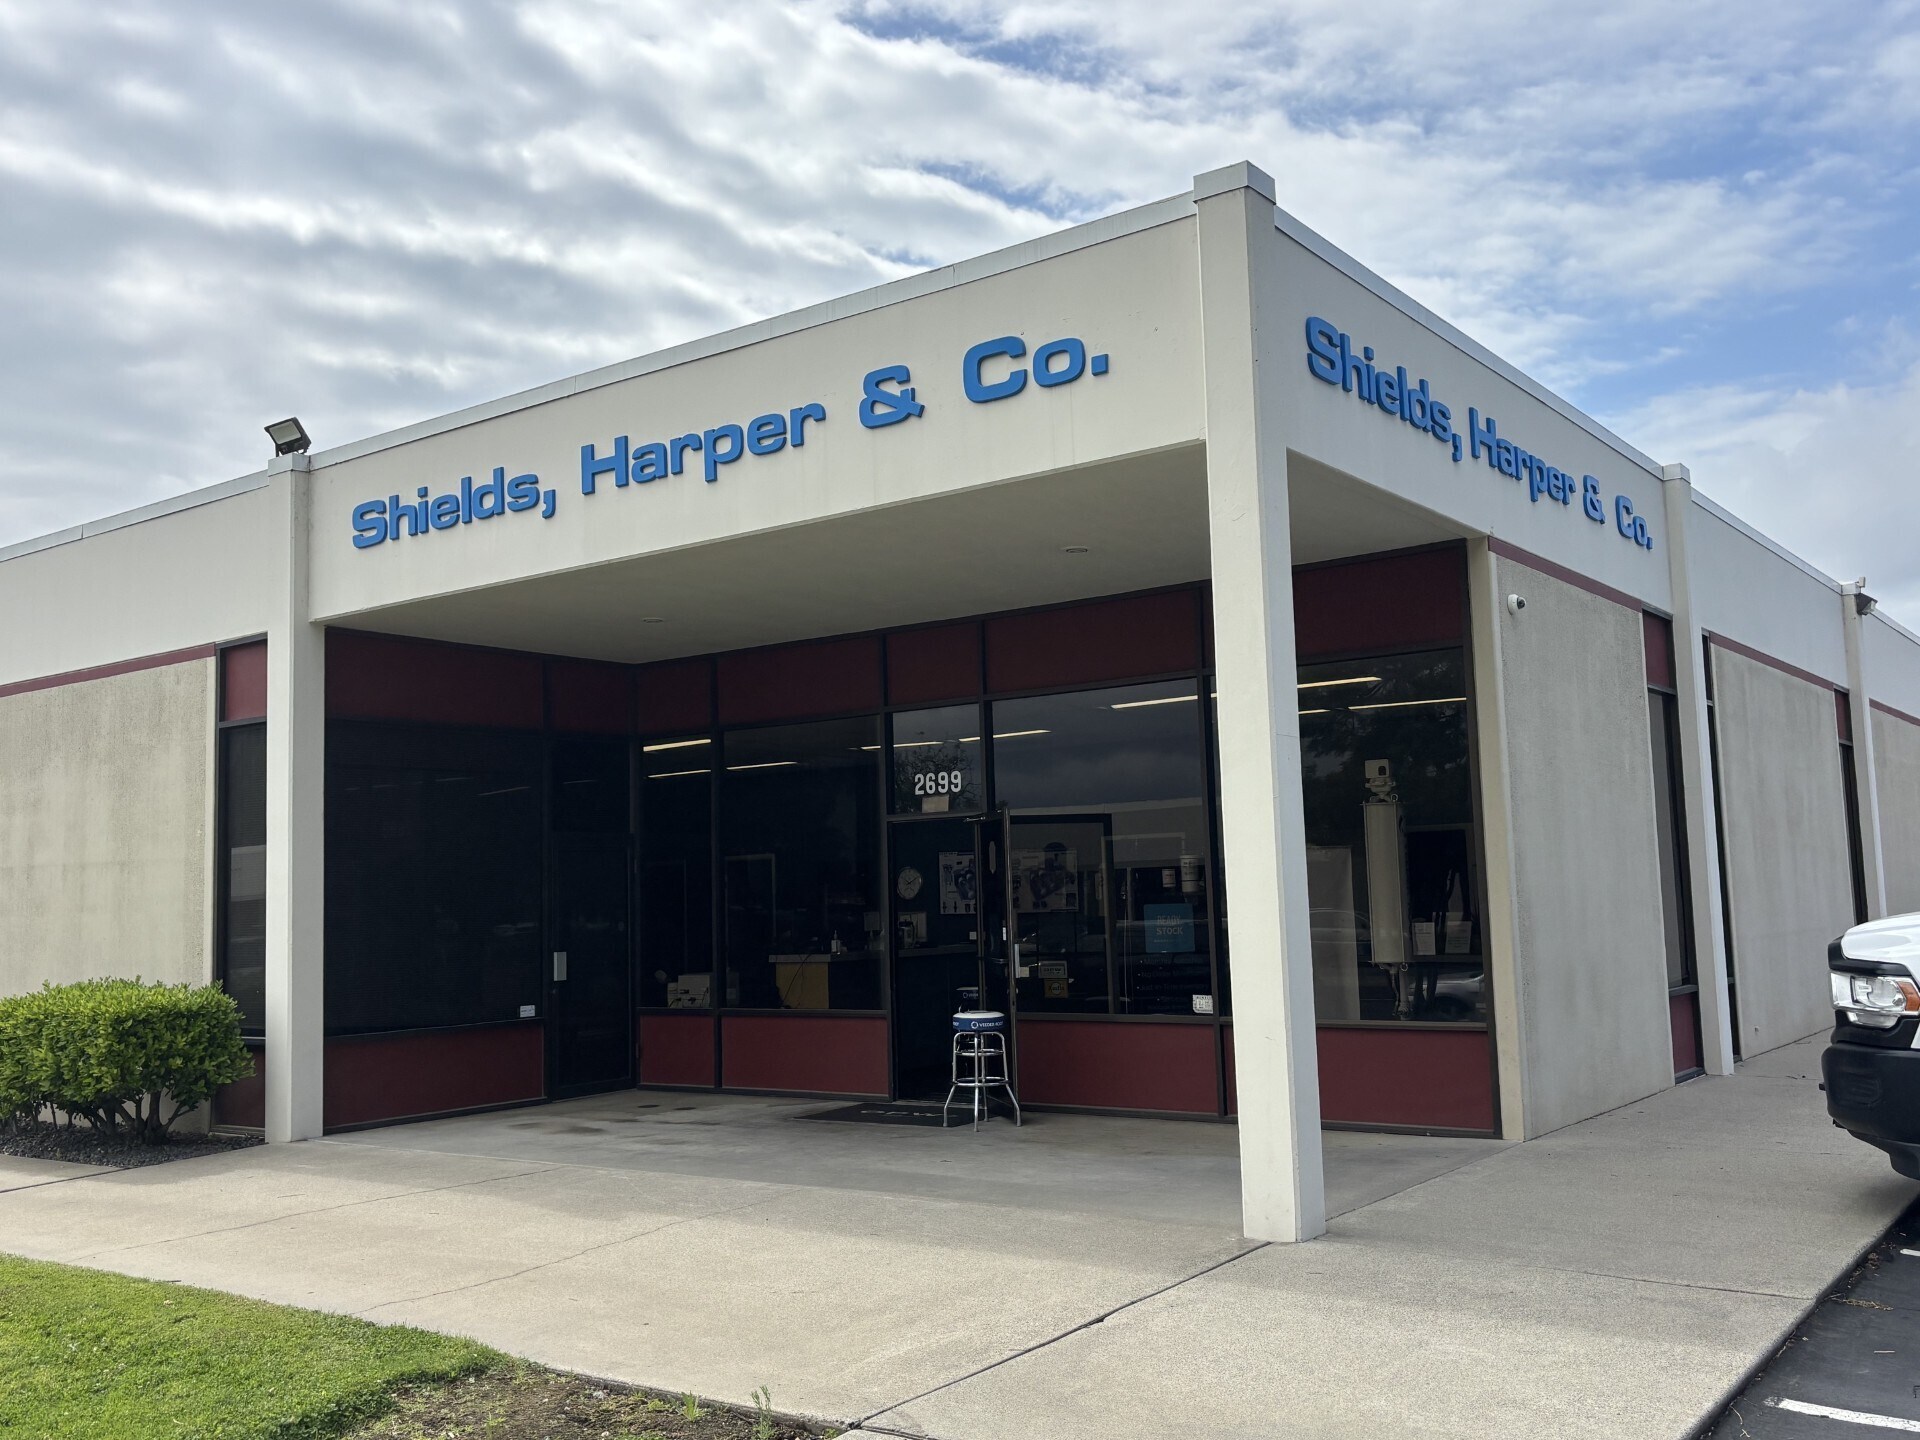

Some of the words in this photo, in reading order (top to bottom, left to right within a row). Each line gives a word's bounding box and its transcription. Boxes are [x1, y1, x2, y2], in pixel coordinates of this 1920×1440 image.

[352, 466, 557, 549] Shields,
[580, 402, 827, 495] Harper
[859, 364, 925, 430] &
[962, 335, 1109, 404] Co.
[1305, 316, 1463, 462] Shields,
[1468, 406, 1577, 505] Harper
[1583, 475, 1605, 525] &
[1615, 495, 1653, 551] Co.
[914, 770, 962, 796] 2699
[1156, 926, 1183, 936] STOCK
[1157, 914, 1182, 926] READY
